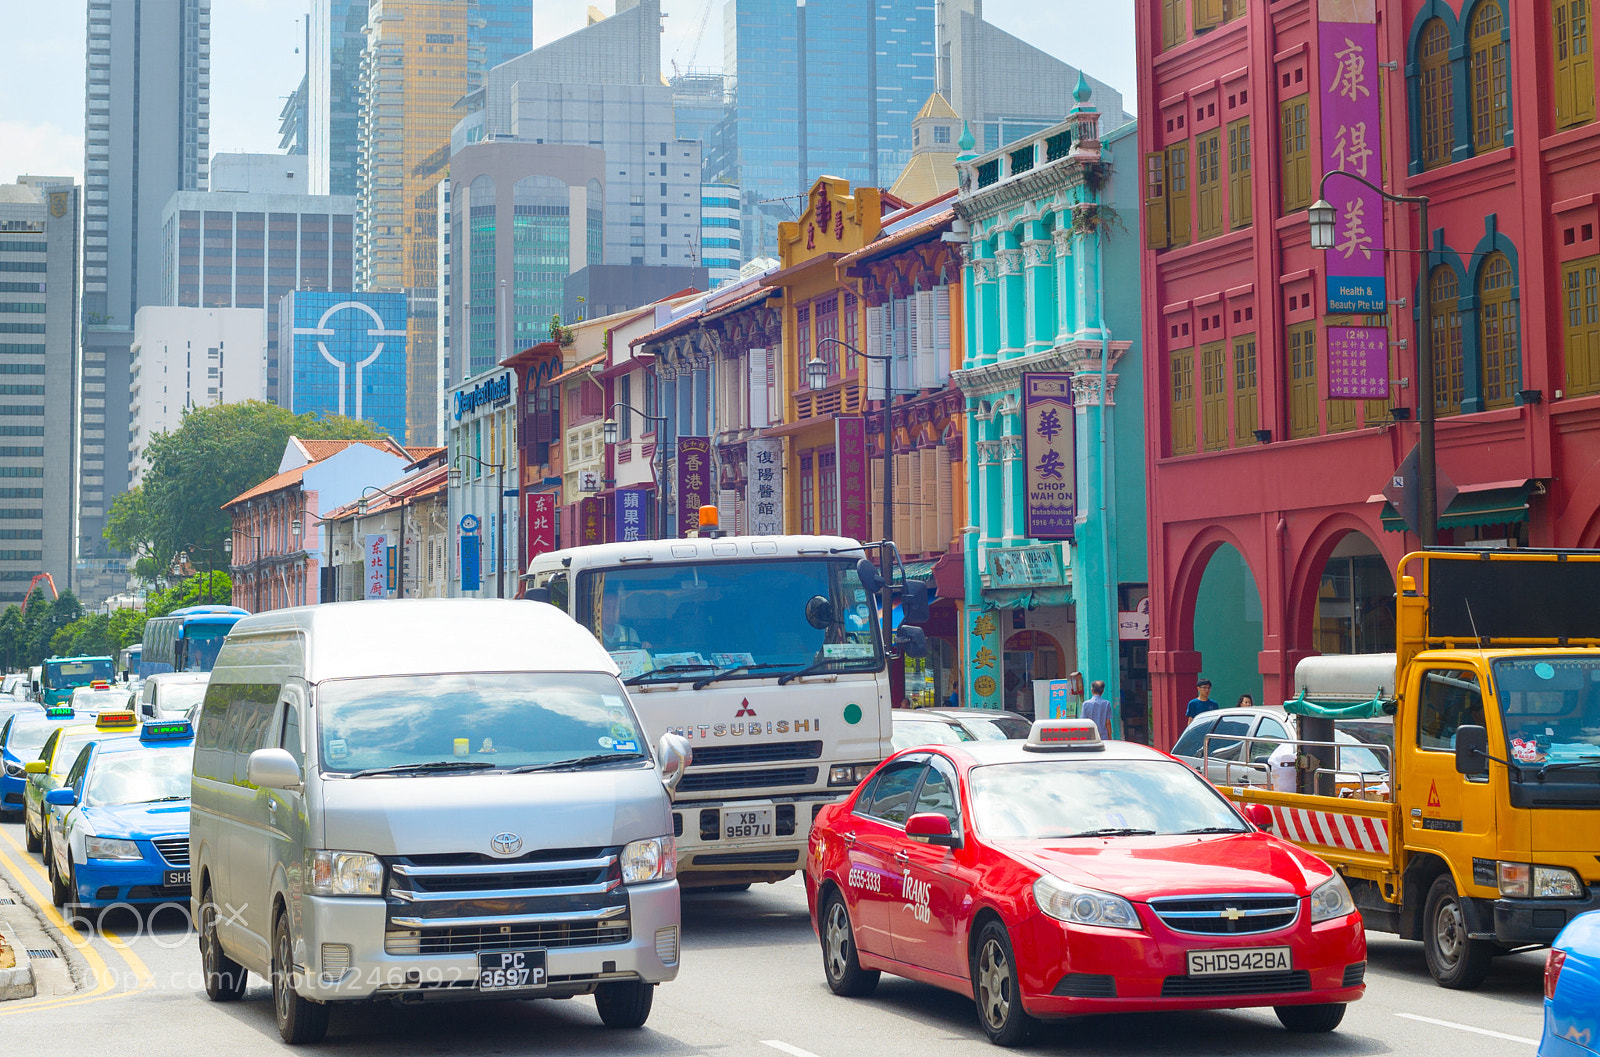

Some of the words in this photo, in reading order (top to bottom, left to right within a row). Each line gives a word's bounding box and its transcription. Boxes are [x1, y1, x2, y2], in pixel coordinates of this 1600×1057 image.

[1328, 37, 1373, 260] 康得美
[1340, 286, 1365, 296] Health
[1366, 286, 1373, 296] &
[1330, 300, 1356, 311] Beauty
[1357, 300, 1370, 310] Pte
[1372, 301, 1384, 310] Ltd
[1035, 408, 1065, 480] 華安
[1037, 483, 1066, 491] CHOP
[1031, 492, 1055, 501] WAH
[1057, 492, 1072, 501] ON
[1032, 508, 1072, 516] Established
[532, 496, 550, 554] 东北人
[758, 523, 776, 532] FYT
[971, 614, 997, 669] 華安
[740, 813, 756, 824] XB
[849, 868, 881, 893] 6555-3333
[501, 952, 525, 970] PC
[1191, 952, 1287, 972] SHD9428A
